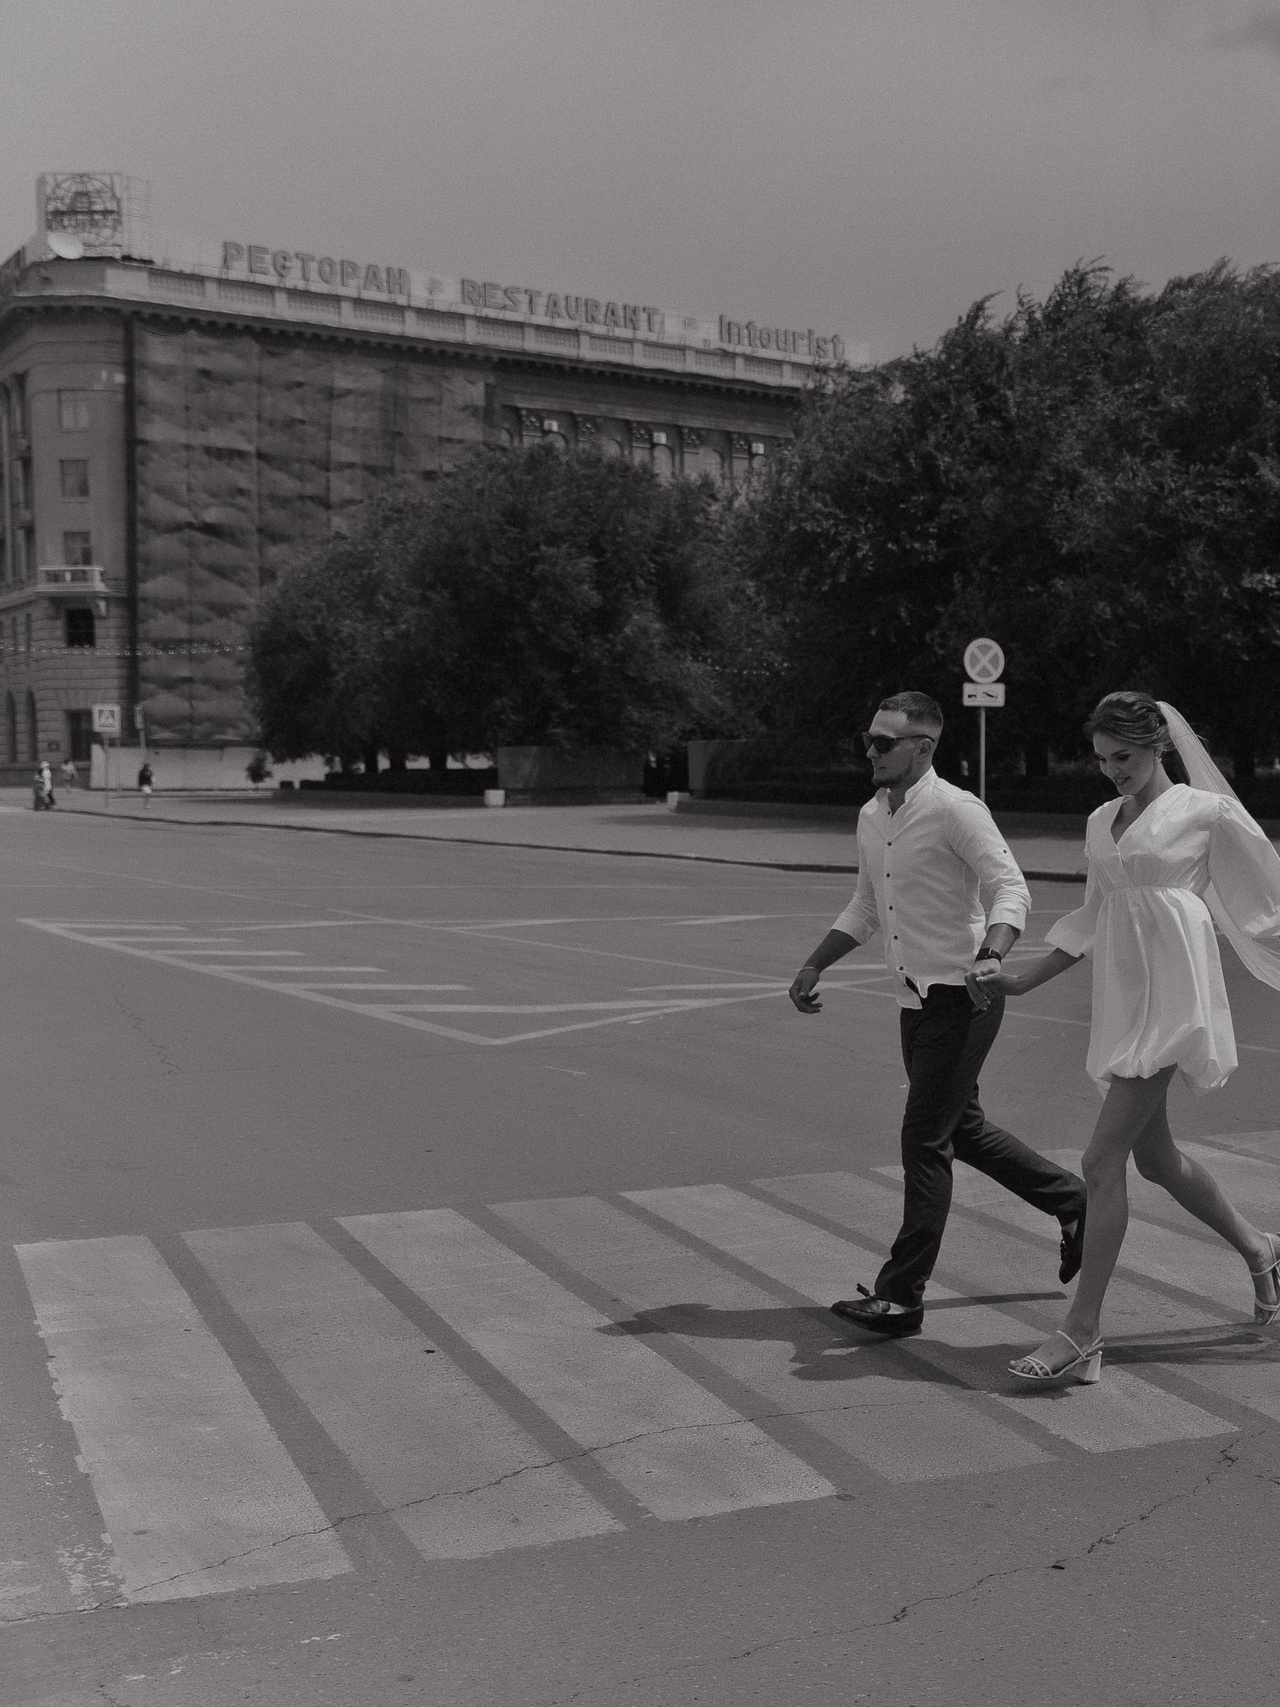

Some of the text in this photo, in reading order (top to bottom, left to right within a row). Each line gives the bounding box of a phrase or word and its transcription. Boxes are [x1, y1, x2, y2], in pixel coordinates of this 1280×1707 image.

[223, 241, 410, 296] РЕСТОРАН
[461, 278, 660, 333] RESTAURANT
[719, 313, 844, 360] Intourist
